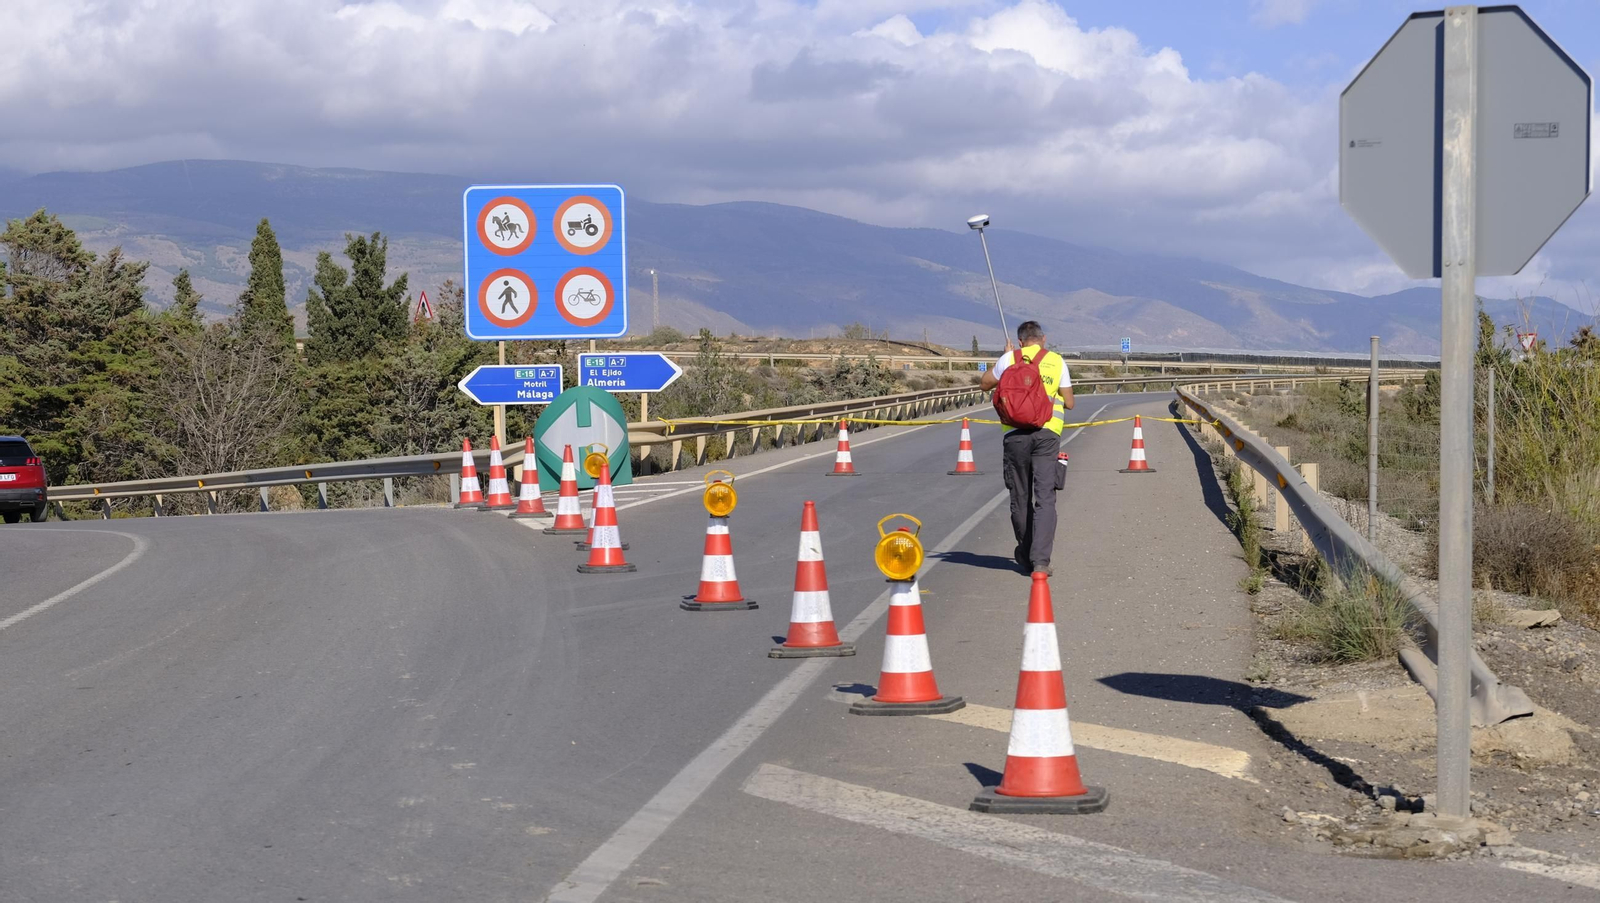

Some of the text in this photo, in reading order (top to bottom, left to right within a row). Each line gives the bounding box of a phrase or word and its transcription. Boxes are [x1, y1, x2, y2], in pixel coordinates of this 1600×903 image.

[602, 369, 622, 377] Ejido
[587, 378, 626, 387] Almería
[517, 389, 554, 400] Málaga
